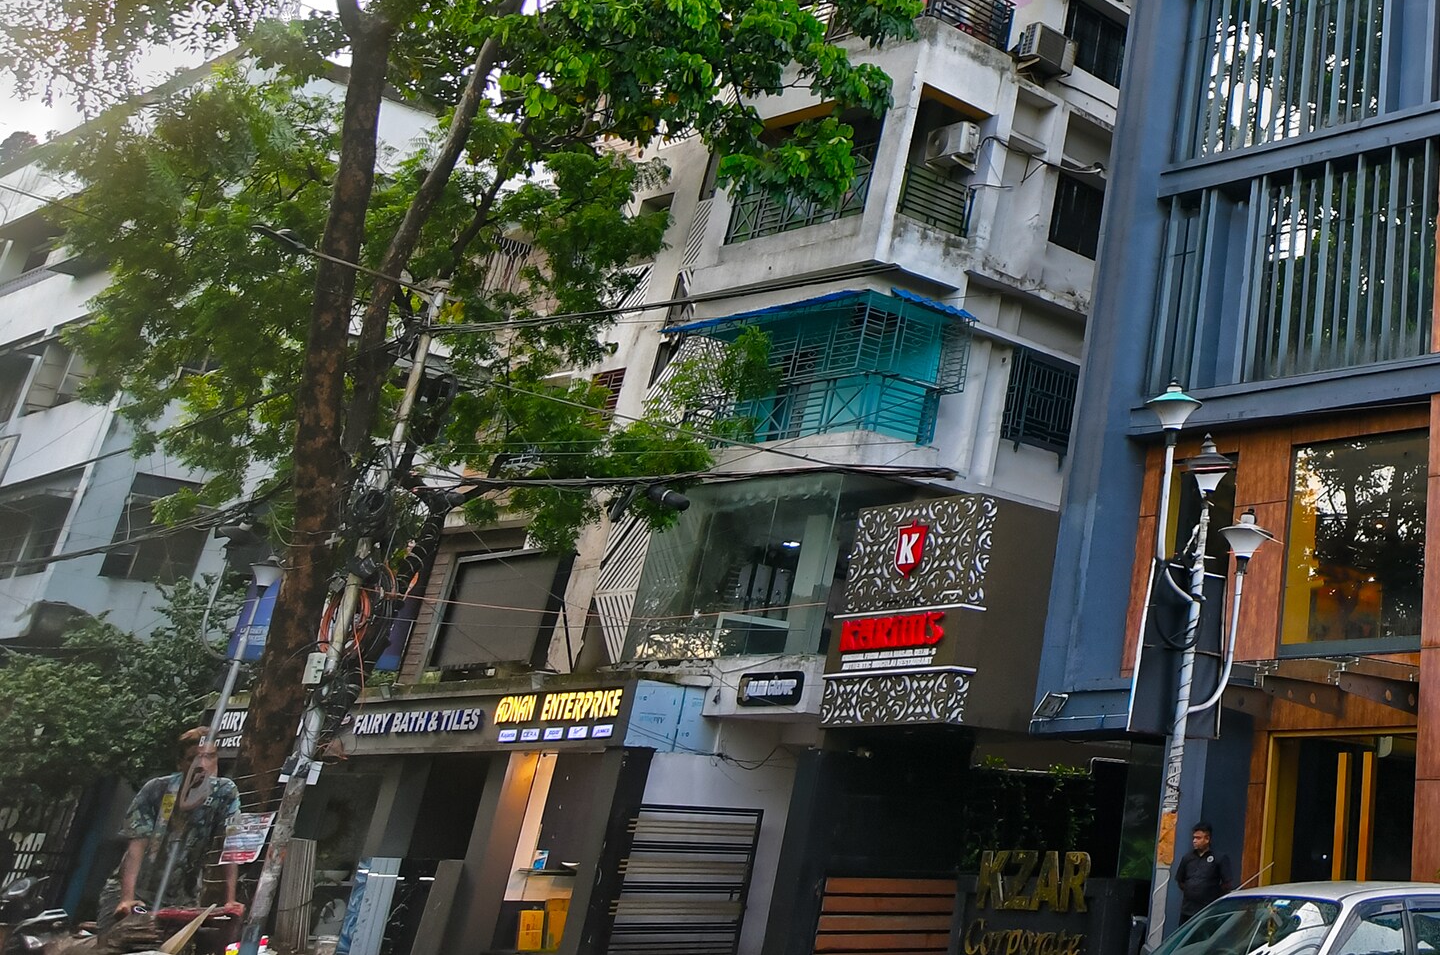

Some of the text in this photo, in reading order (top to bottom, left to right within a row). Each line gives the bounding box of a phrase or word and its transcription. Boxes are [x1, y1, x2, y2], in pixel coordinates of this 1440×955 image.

[898, 533, 920, 564] K
[219, 711, 249, 732] AIRY
[352, 708, 481, 735] FAIRY BATH & TILES
[494, 688, 623, 725] ADNAN ENTERPRISE
[976, 849, 1092, 913] KZAR
[964, 917, 1085, 955] Corporate
